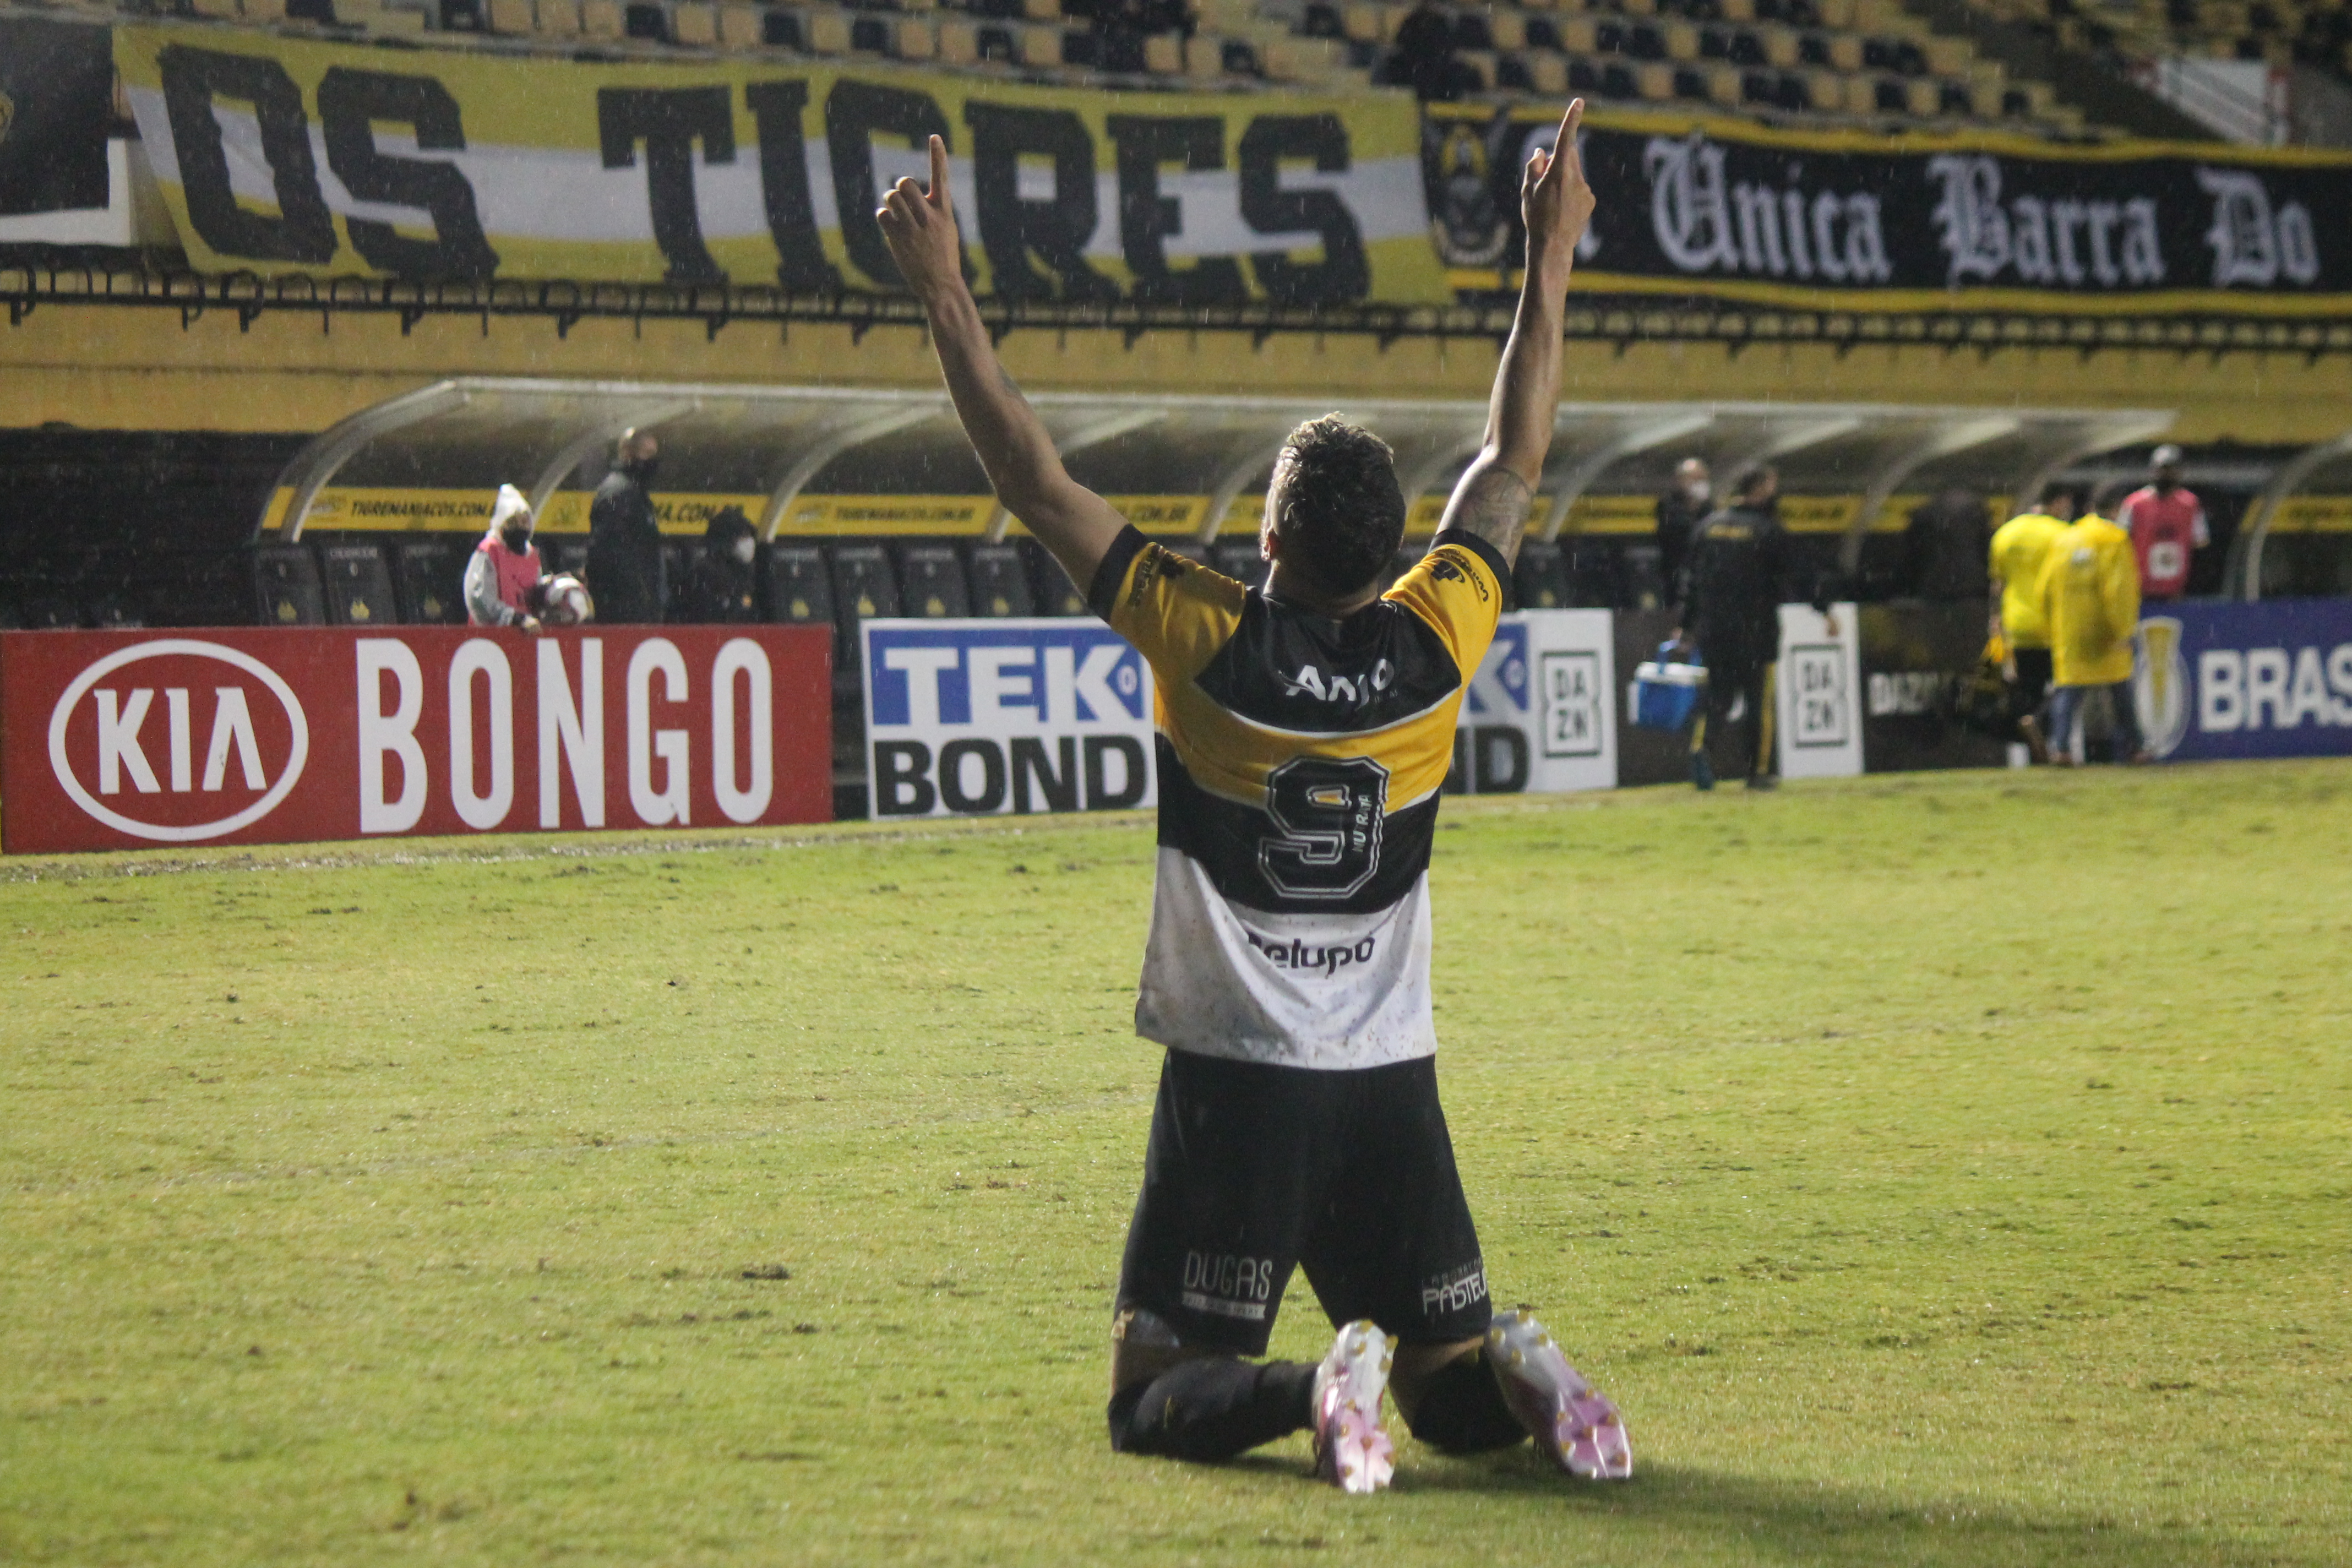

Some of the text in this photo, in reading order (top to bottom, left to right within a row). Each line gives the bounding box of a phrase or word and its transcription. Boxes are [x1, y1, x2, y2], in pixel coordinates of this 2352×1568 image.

[156, 43, 500, 282] OS
[597, 78, 1371, 306] TIGRES
[1926, 153, 2167, 292] Barra
[93, 687, 268, 795] KIA
[356, 636, 772, 833] BONGO
[884, 644, 1135, 726] TEK
[874, 734, 1147, 815] BOND
[1257, 755, 1390, 899] 9
[1184, 1249, 1273, 1301] DUGAS
